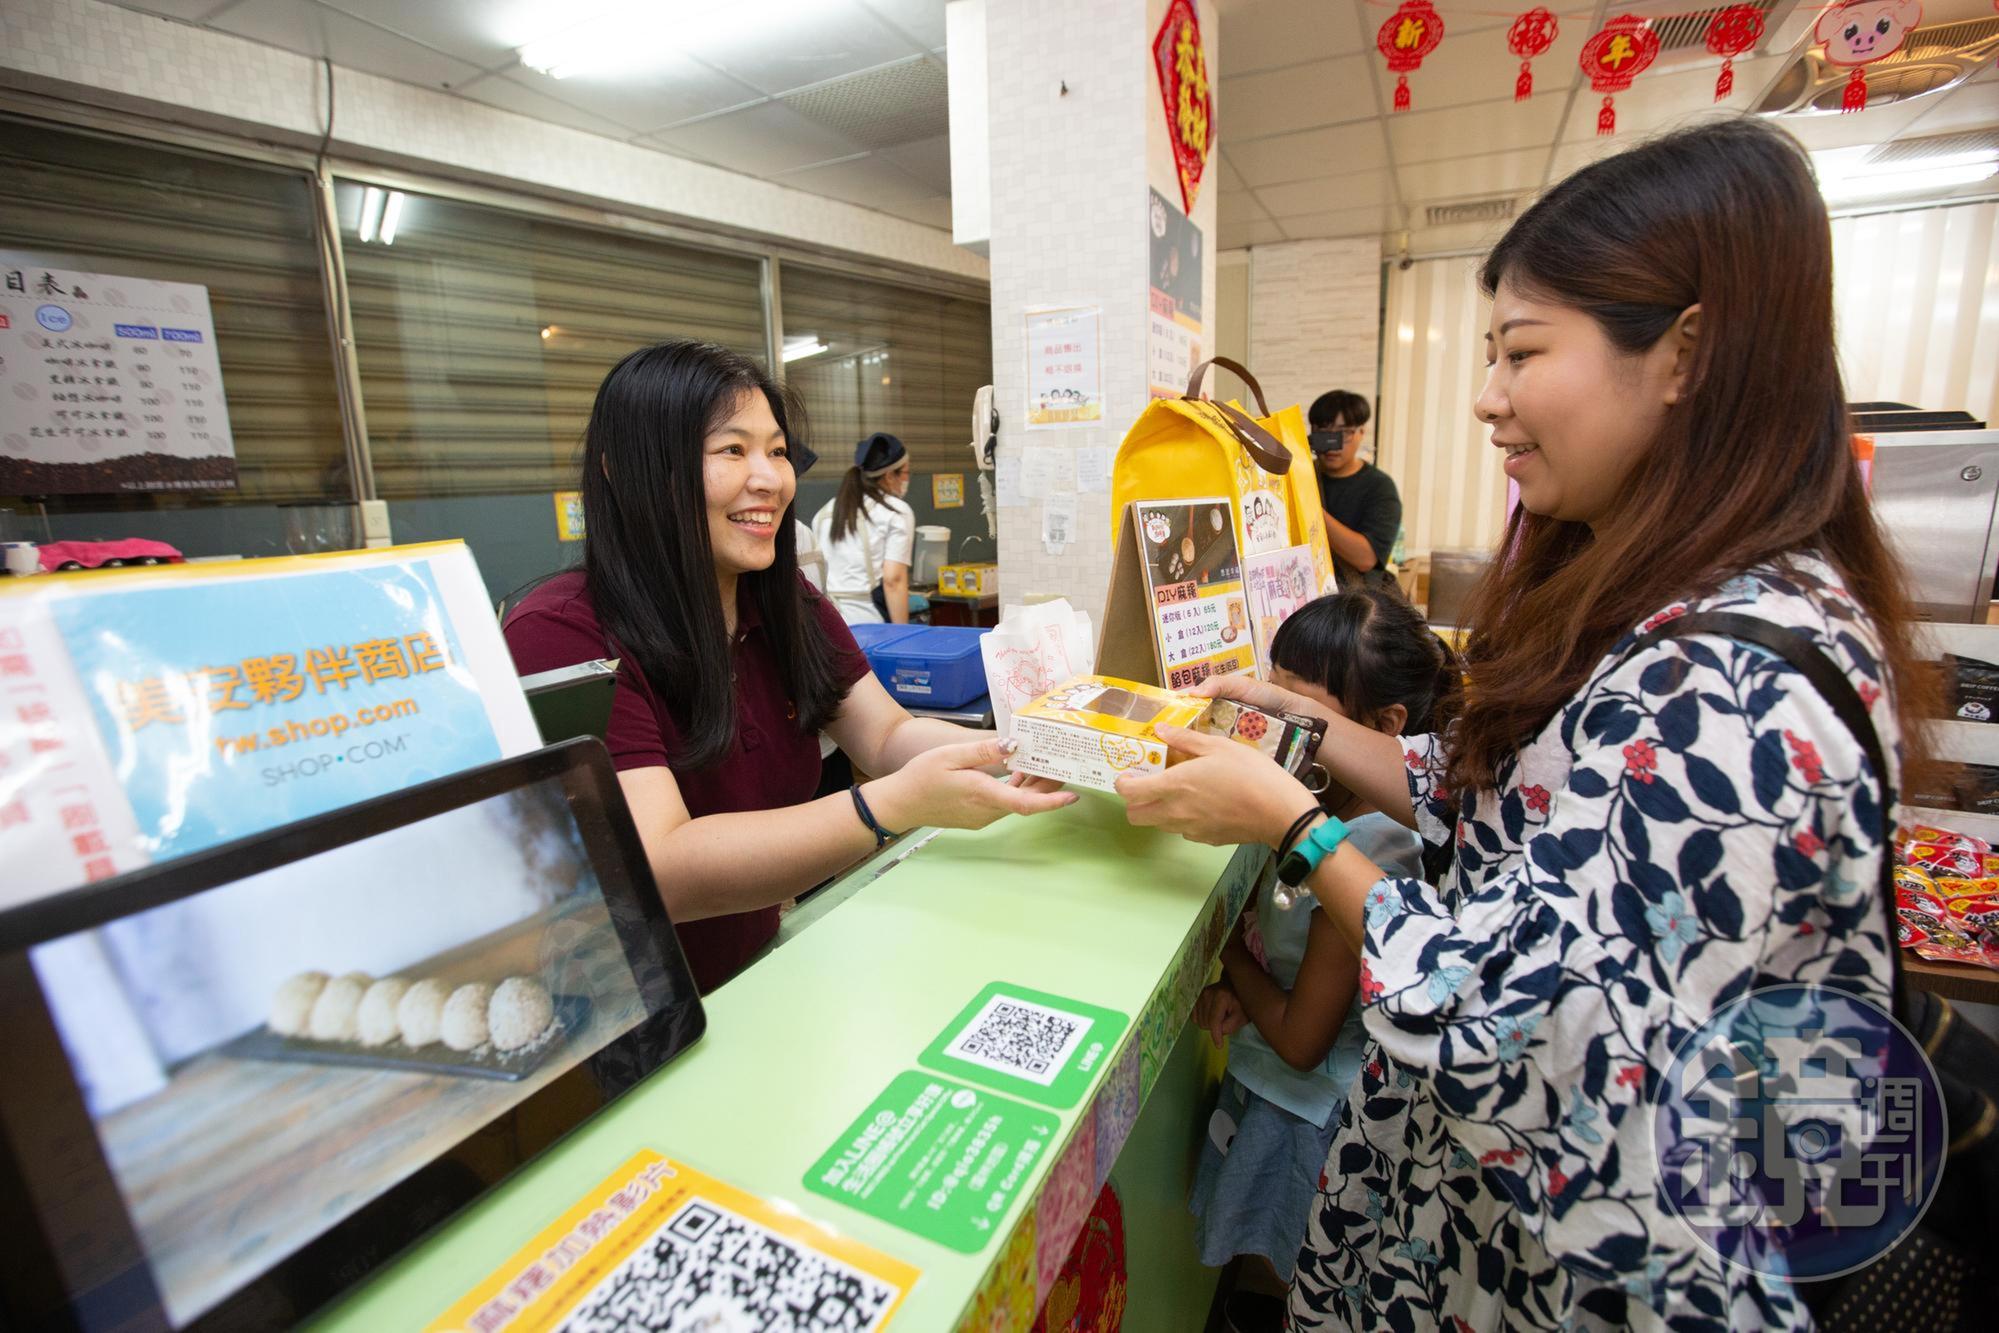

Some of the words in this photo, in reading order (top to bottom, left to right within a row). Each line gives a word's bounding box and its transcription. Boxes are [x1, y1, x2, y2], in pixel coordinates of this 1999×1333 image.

[1395, 16, 1425, 49] 新
[1600, 34, 1636, 70] 年
[41, 311, 68, 324] Ice
